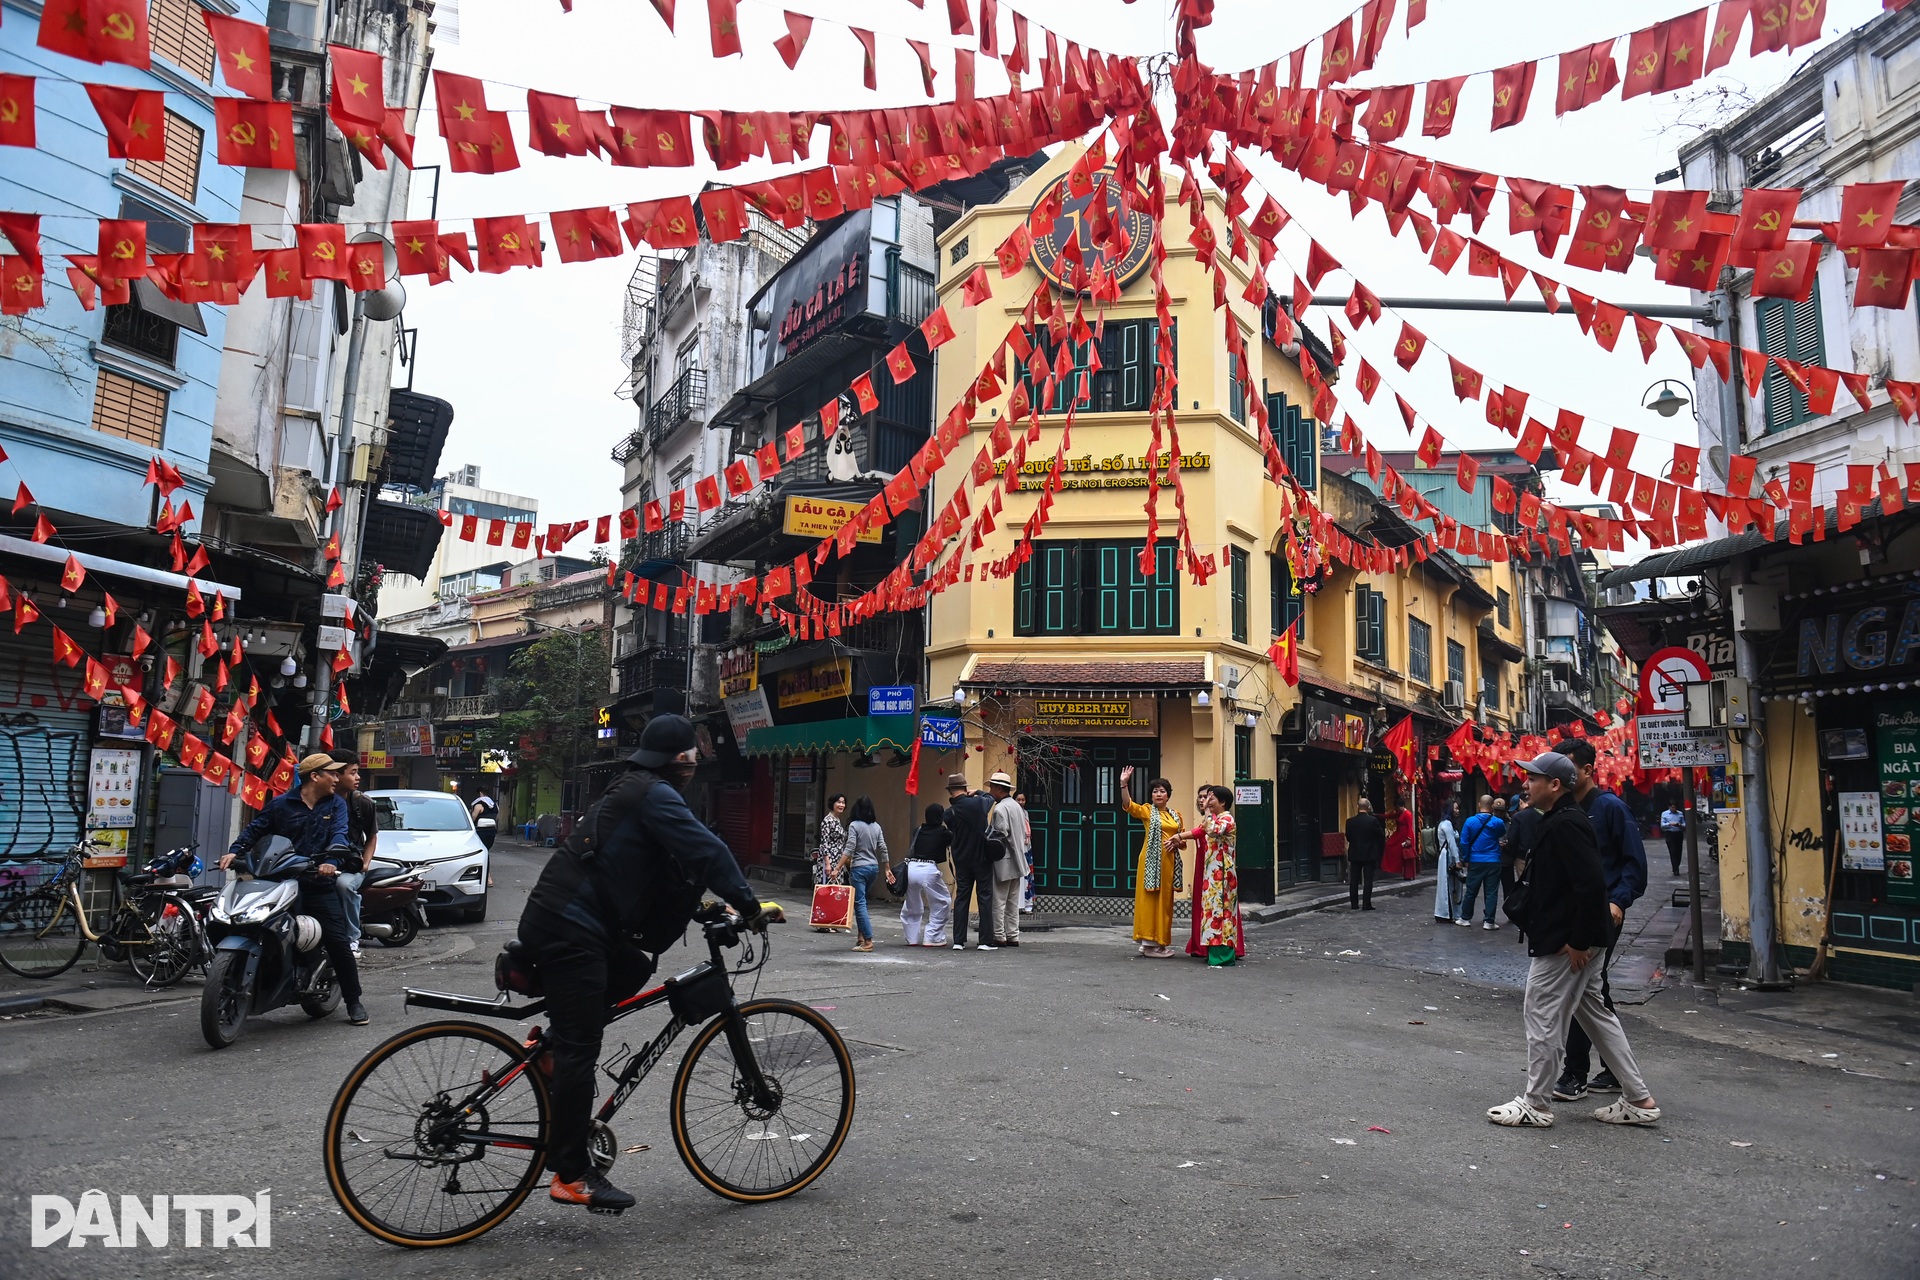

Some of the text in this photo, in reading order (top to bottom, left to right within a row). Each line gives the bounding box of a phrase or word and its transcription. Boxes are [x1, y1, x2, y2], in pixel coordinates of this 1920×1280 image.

[1115, 256, 1136, 277] HUY
[805, 281, 823, 321] GÀ
[828, 262, 846, 305] LÁ
[848, 251, 859, 288] É
[1071, 455, 1091, 472] TẾ
[1102, 454, 1124, 471] SỐ
[1128, 457, 1135, 470] 1
[1139, 452, 1171, 469] TẾ
[1178, 451, 1211, 469] GIỚI
[1080, 480, 1101, 489] NO1
[826, 506, 846, 518] GÀ
[1686, 632, 1735, 665] Bia
[887, 689, 902, 697] PHỐ
[886, 700, 897, 712] NGỌC
[1039, 703, 1127, 714] HUY BEER TAY
[1115, 717, 1136, 726] QUỐC
[1640, 721, 1647, 729] XE
[1877, 713, 1900, 727] Trúc
[923, 730, 935, 743] TẠ
[1668, 743, 1688, 753] NGOA
[1894, 743, 1917, 754] BIA
[1883, 760, 1920, 774] NGÃ T
